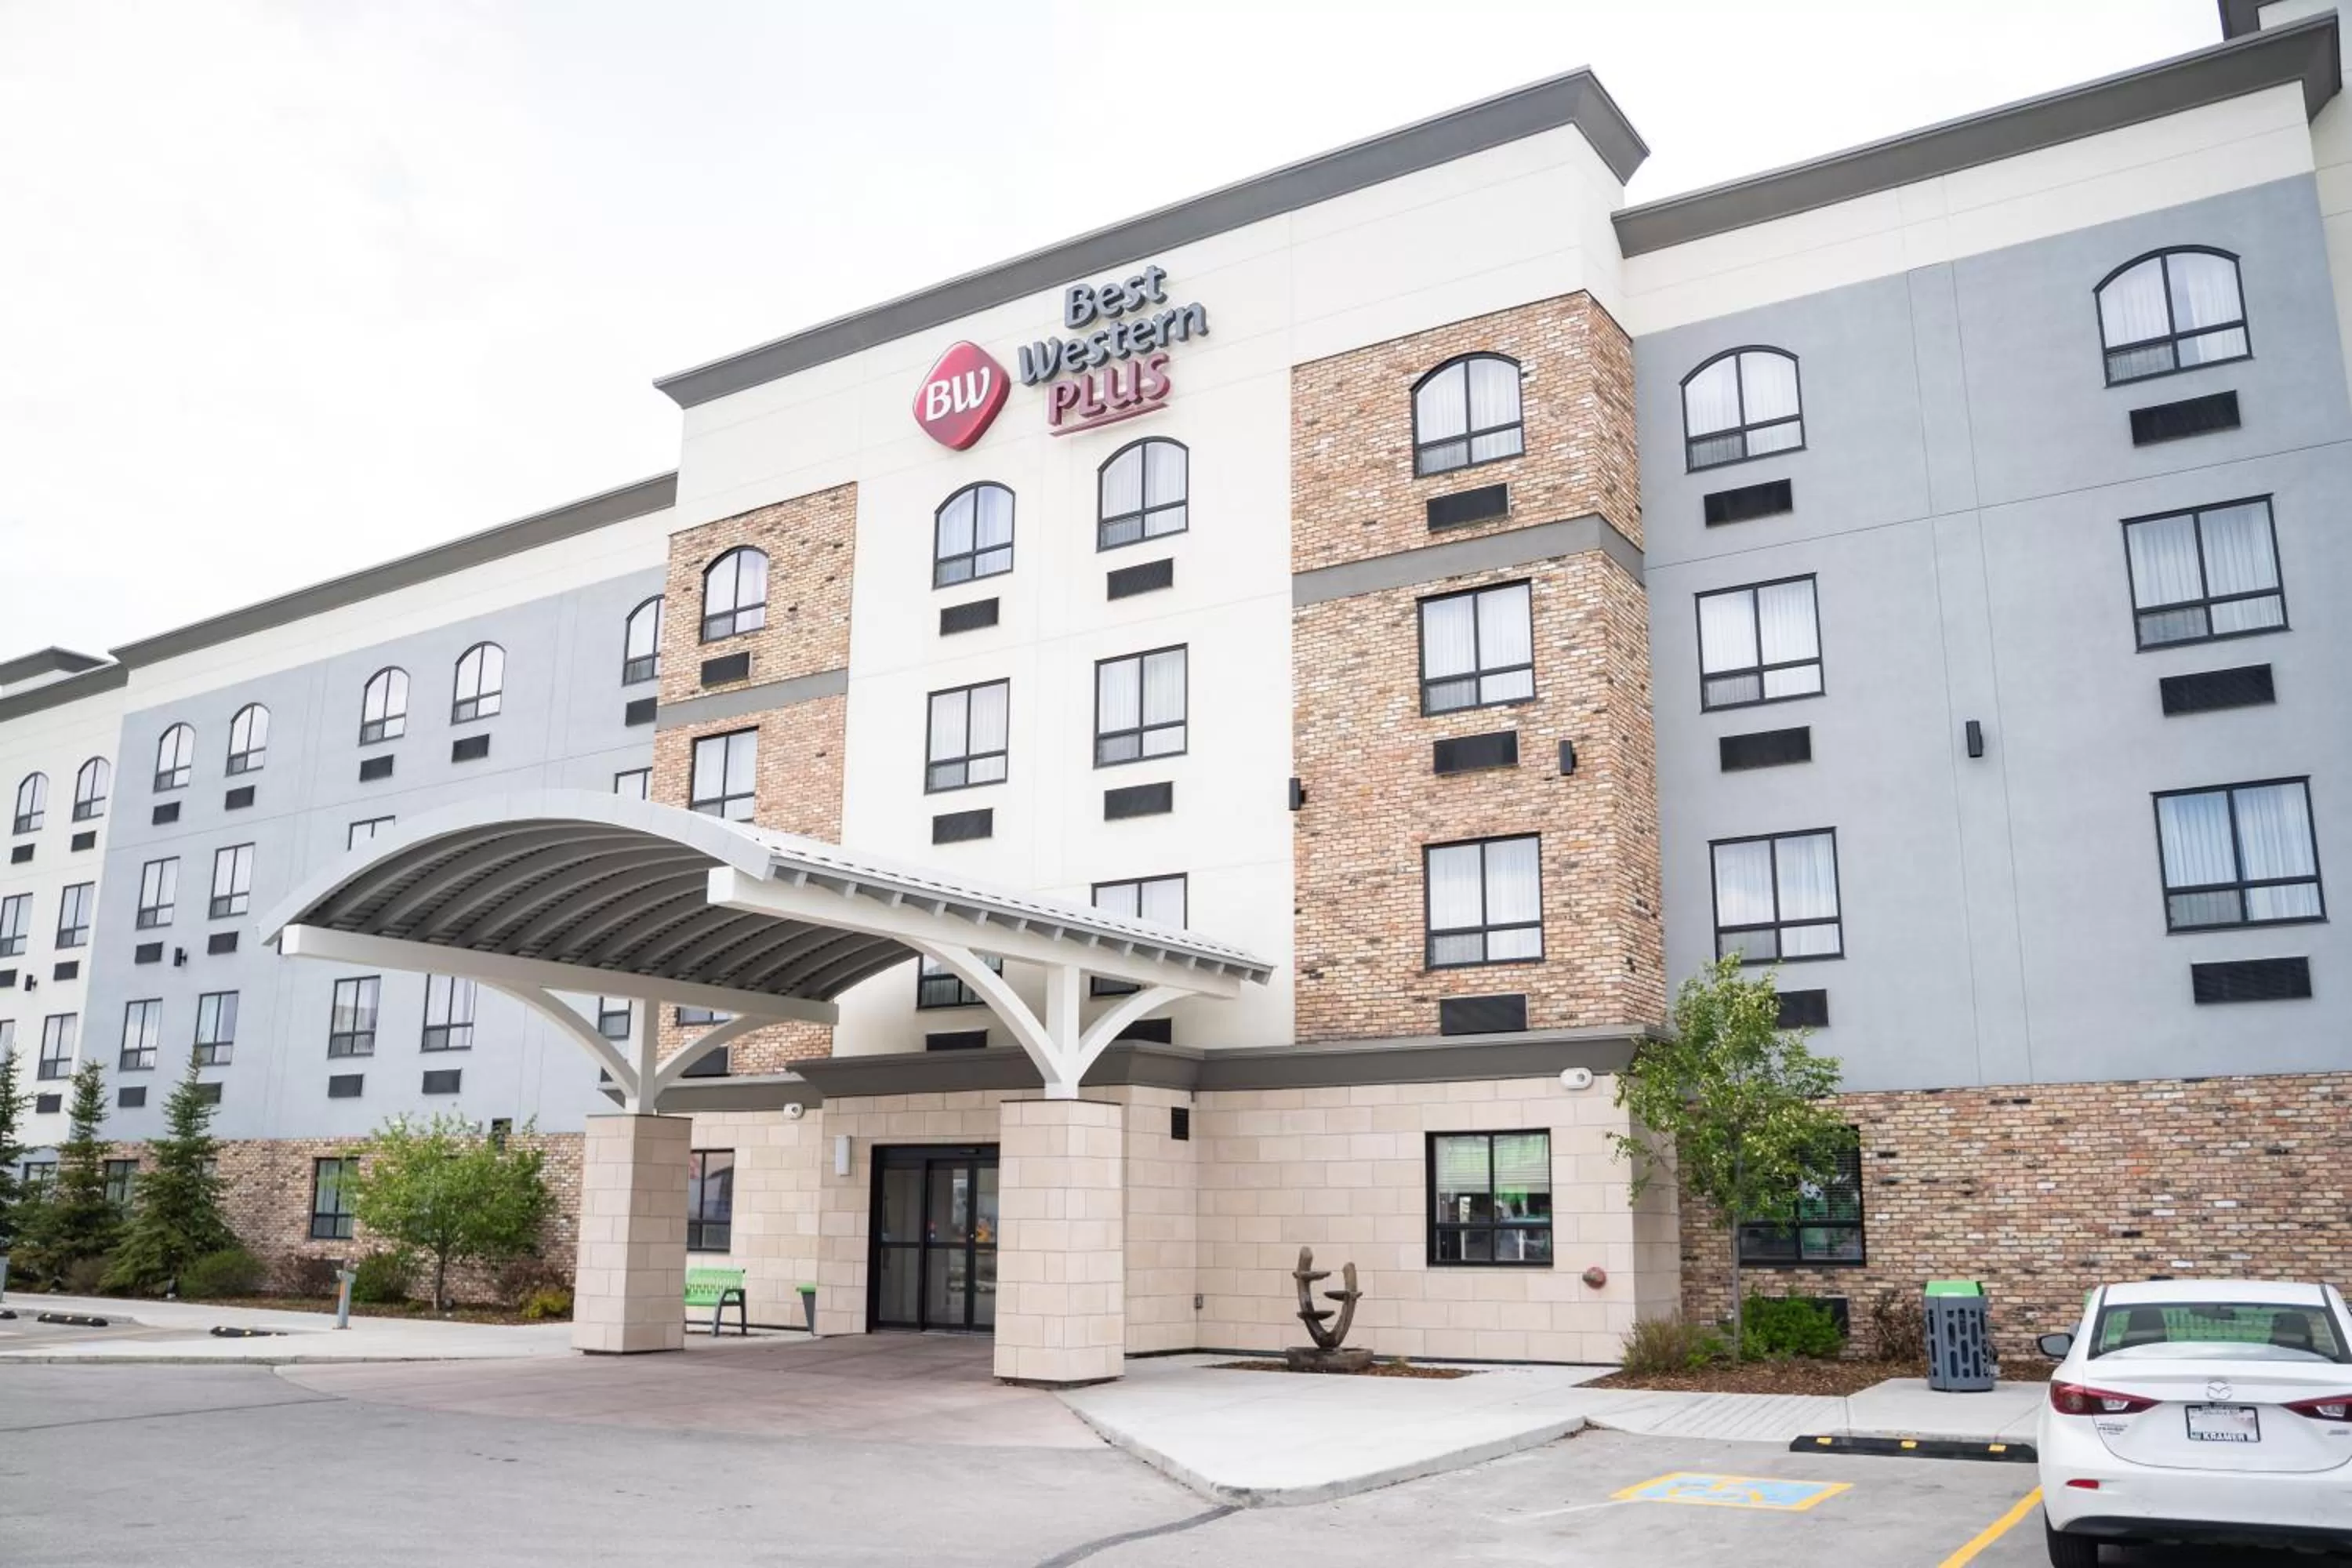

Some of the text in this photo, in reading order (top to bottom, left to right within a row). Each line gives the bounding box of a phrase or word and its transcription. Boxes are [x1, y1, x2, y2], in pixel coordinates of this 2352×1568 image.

[1064, 265, 1167, 329] Best
[1018, 302, 1209, 387] Western
[926, 366, 990, 422] BW
[1047, 353, 1171, 426] PLUS
